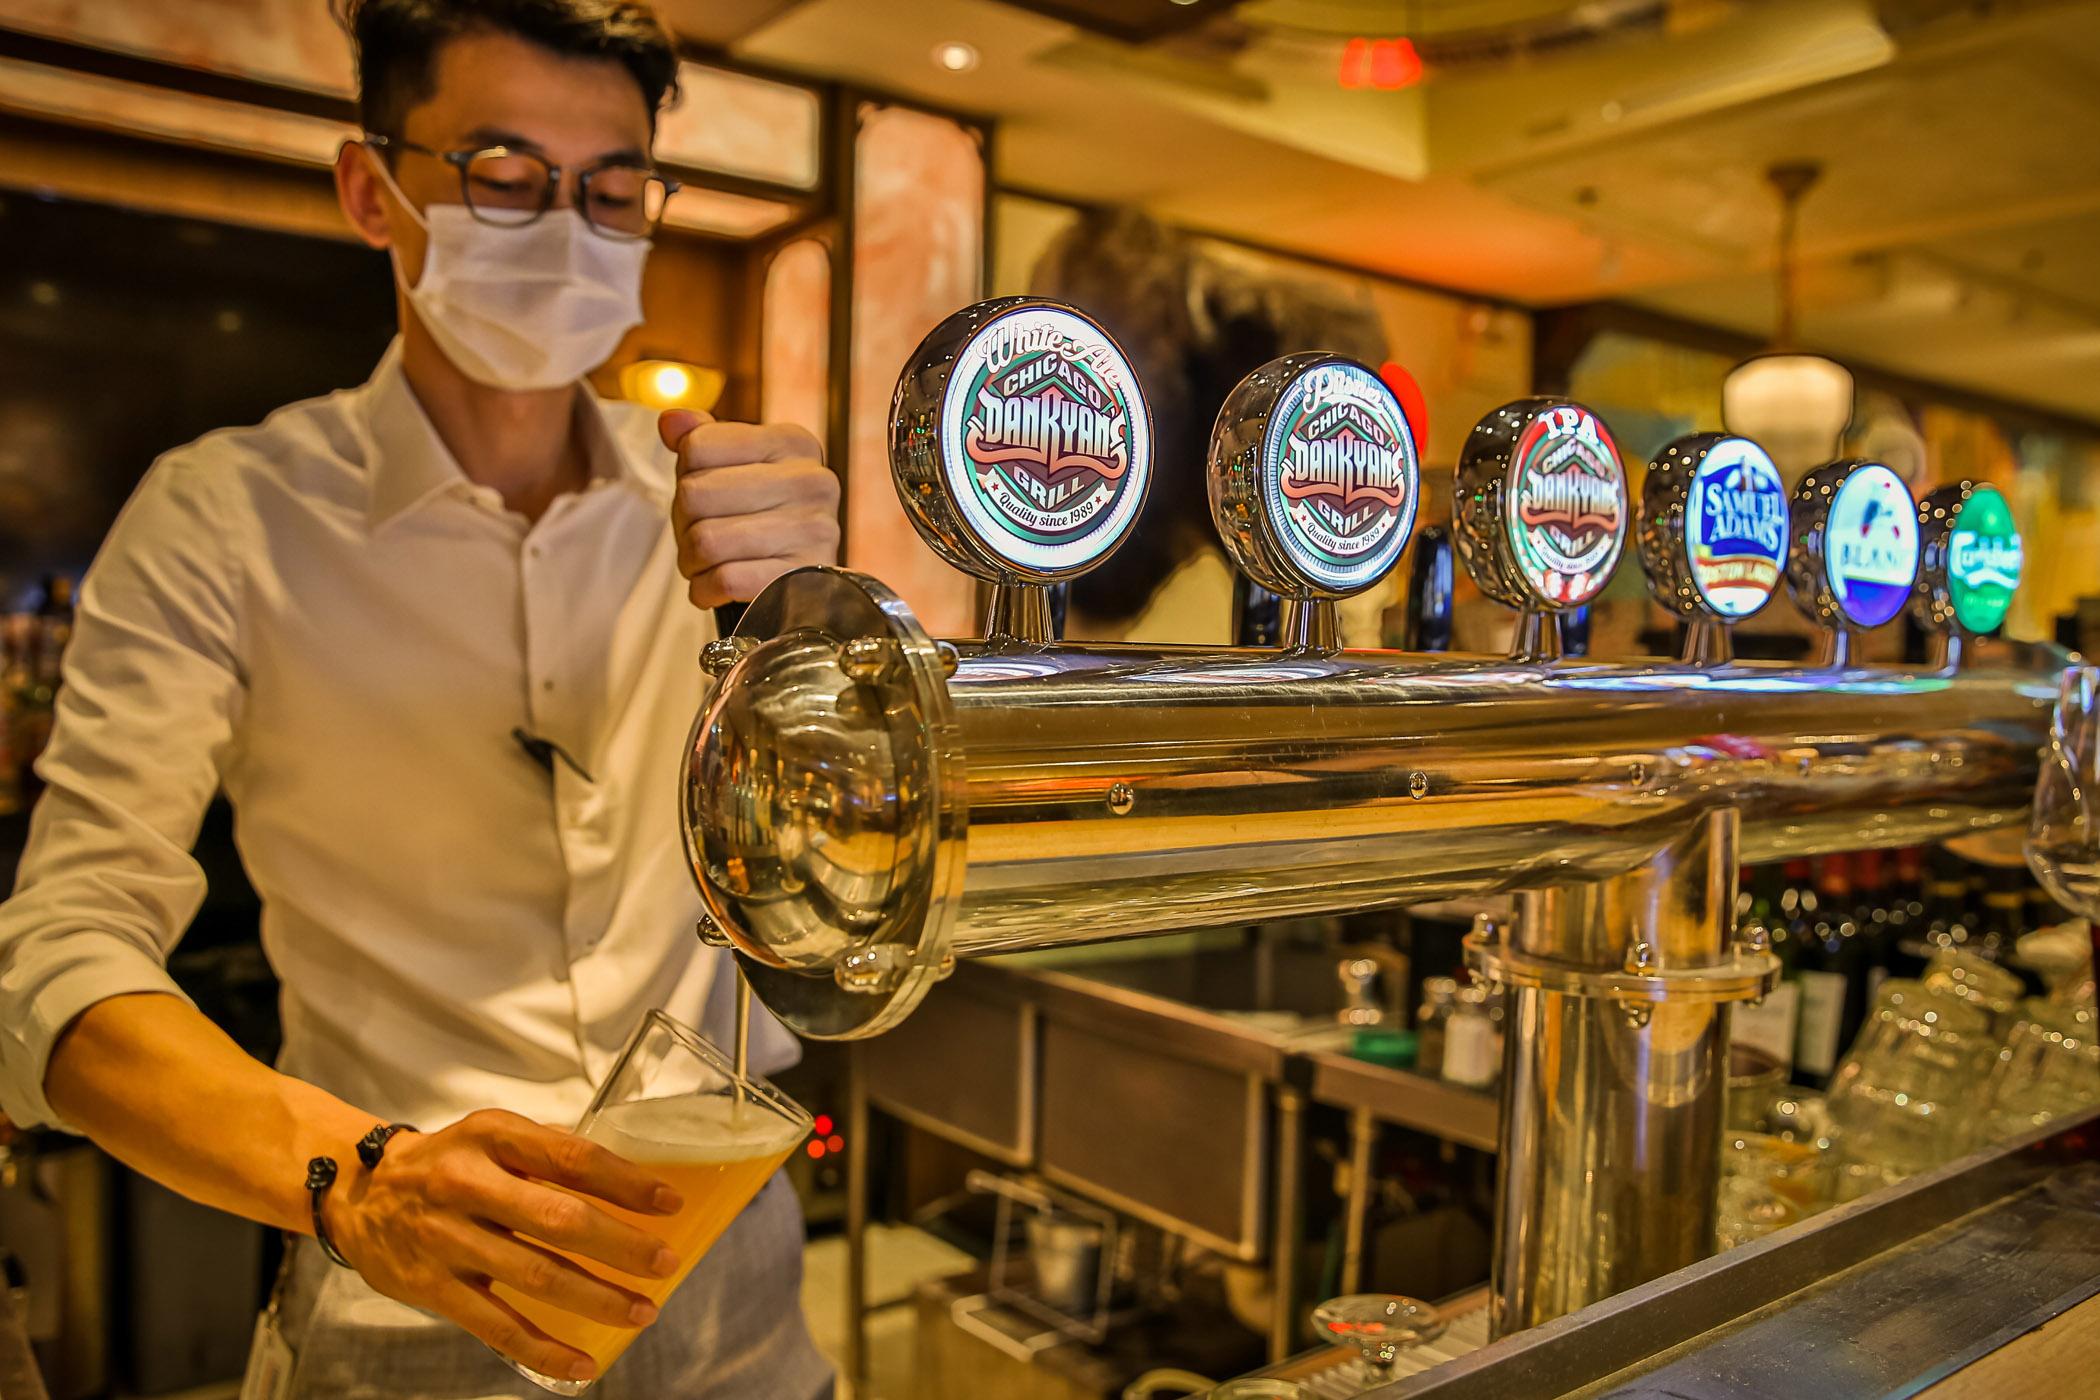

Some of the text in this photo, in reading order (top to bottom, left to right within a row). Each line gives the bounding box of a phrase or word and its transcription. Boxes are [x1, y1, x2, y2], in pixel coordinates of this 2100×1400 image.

[975, 319, 1121, 390] White Ale
[1002, 353, 1103, 410] CHICAGO
[1308, 403, 1385, 445] CHICAGO
[1538, 408, 1600, 446] IPA
[1012, 466, 1085, 509] GRILL
[1705, 482, 1784, 524] SAMUEL
[999, 492, 1094, 527] Quality since 1989
[1317, 498, 1374, 536] GRILL
[1307, 521, 1380, 552] Quality since 1989
[1709, 512, 1779, 552] ADAMS
